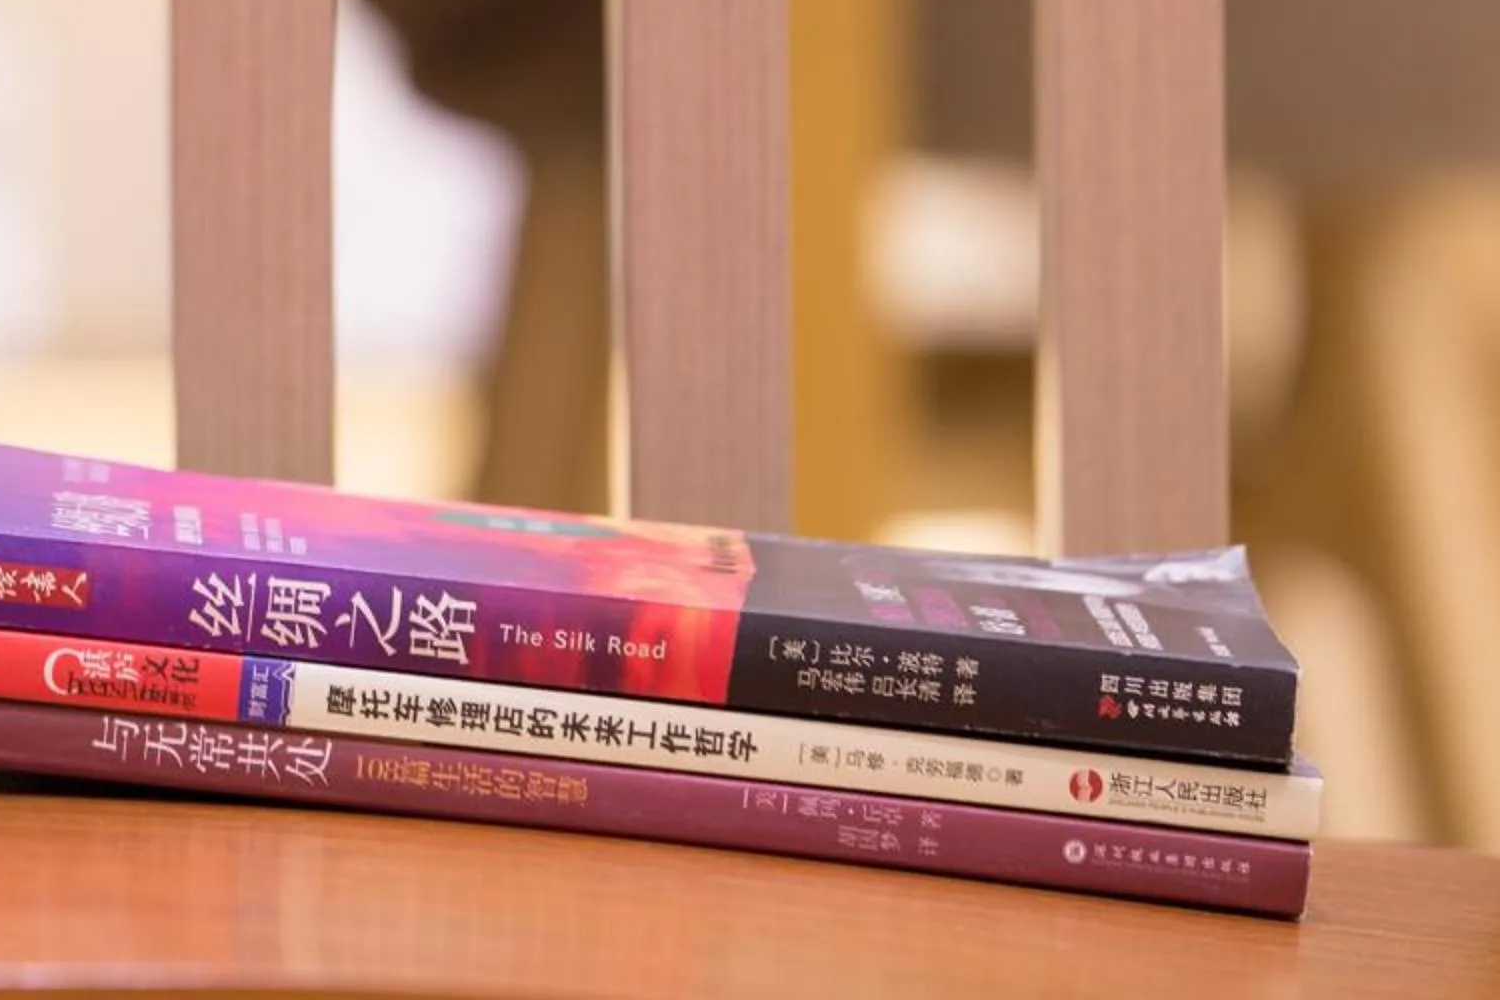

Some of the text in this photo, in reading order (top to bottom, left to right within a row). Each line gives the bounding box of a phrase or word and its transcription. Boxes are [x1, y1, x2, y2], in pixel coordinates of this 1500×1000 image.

[188, 570, 478, 666] 丝绸之路
[499, 623, 668, 661] The Silk Road
[797, 667, 866, 695] 马宏伟
[953, 683, 977, 707] 译
[955, 655, 980, 679] 著
[1100, 673, 1244, 707] 四川出版集团
[325, 683, 759, 763] 摩托车修理店的未来工作哲学
[91, 714, 333, 788] 与无常共处
[1108, 771, 1268, 811] 浙江人民出版社
